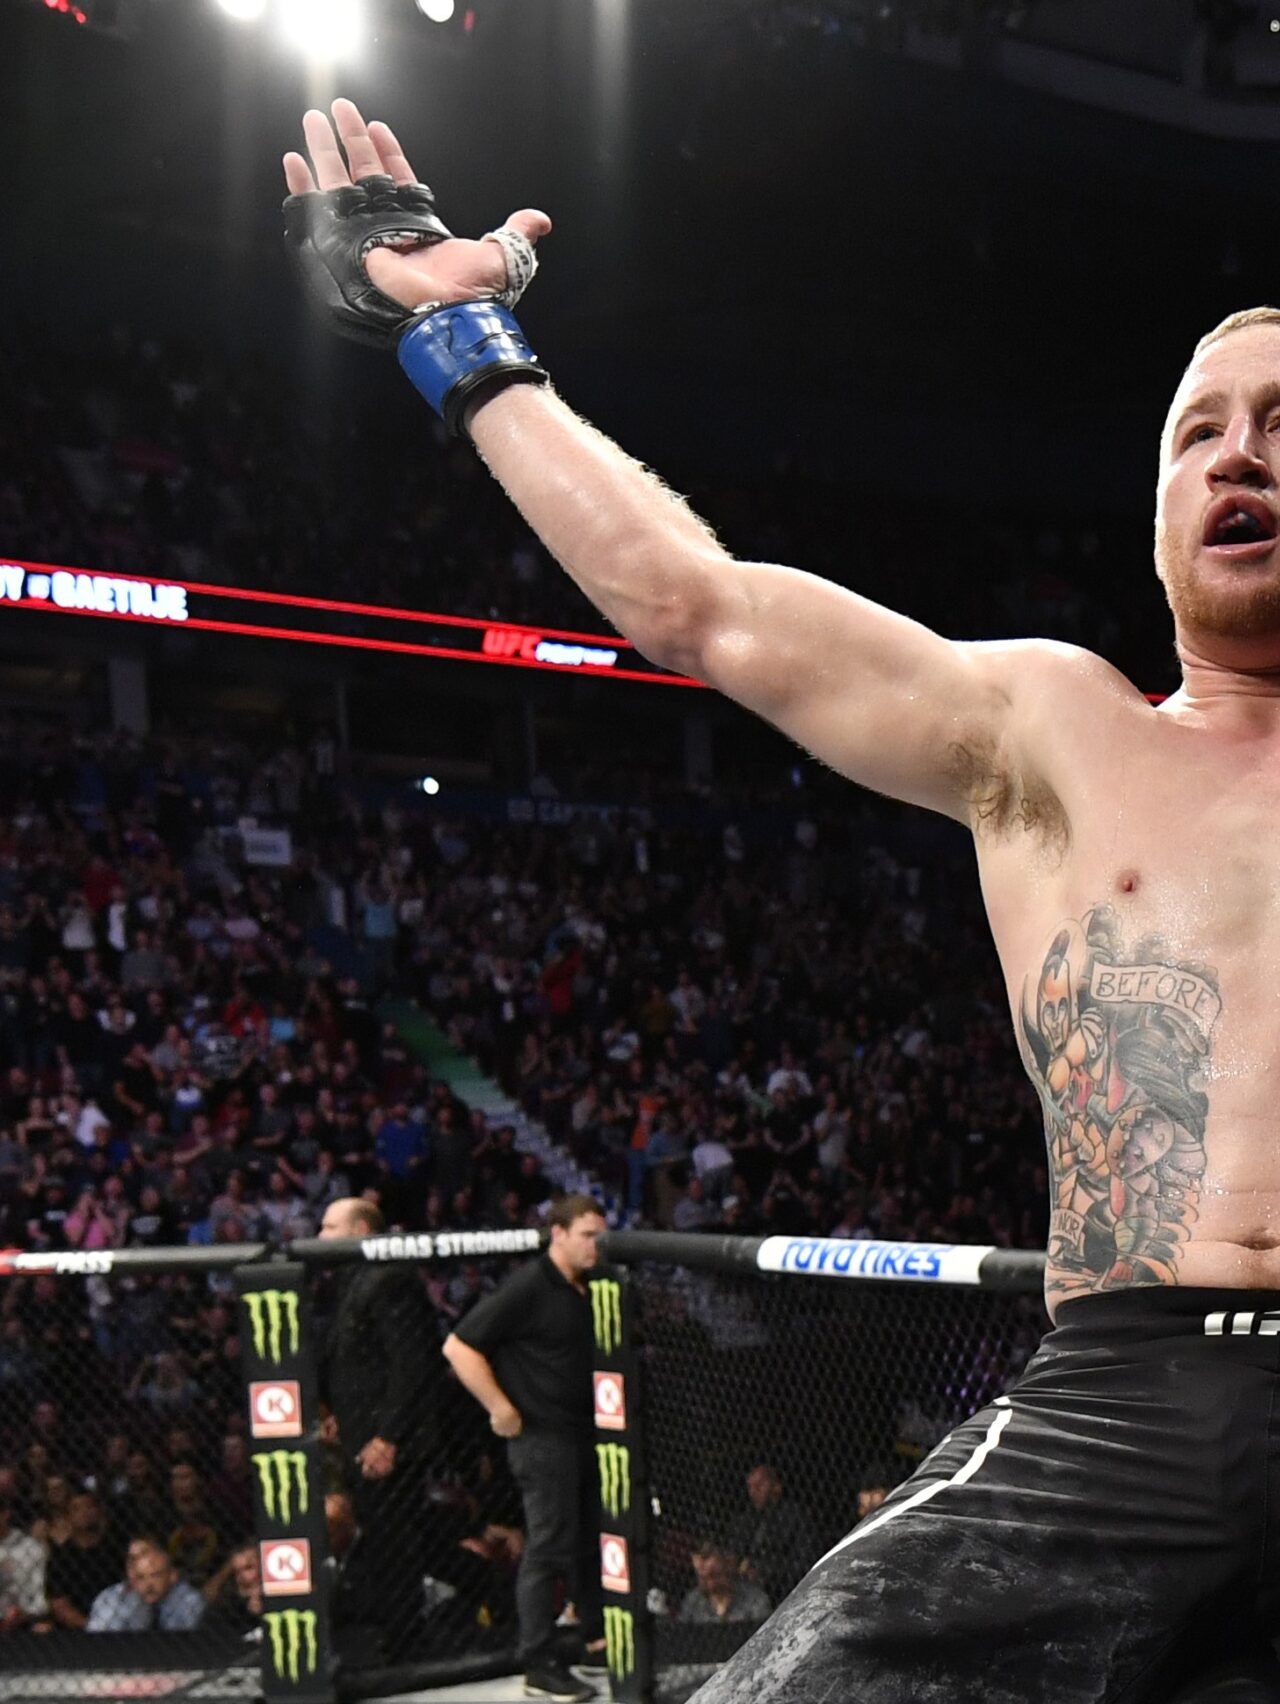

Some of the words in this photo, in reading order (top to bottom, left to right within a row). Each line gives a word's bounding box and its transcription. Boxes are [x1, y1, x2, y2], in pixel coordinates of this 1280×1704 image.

[1096, 971, 1215, 1020] BEFORE
[361, 1234, 433, 1261] VEGAS
[435, 1228, 541, 1258] STRONGER
[856, 1243, 951, 1278] TIRES
